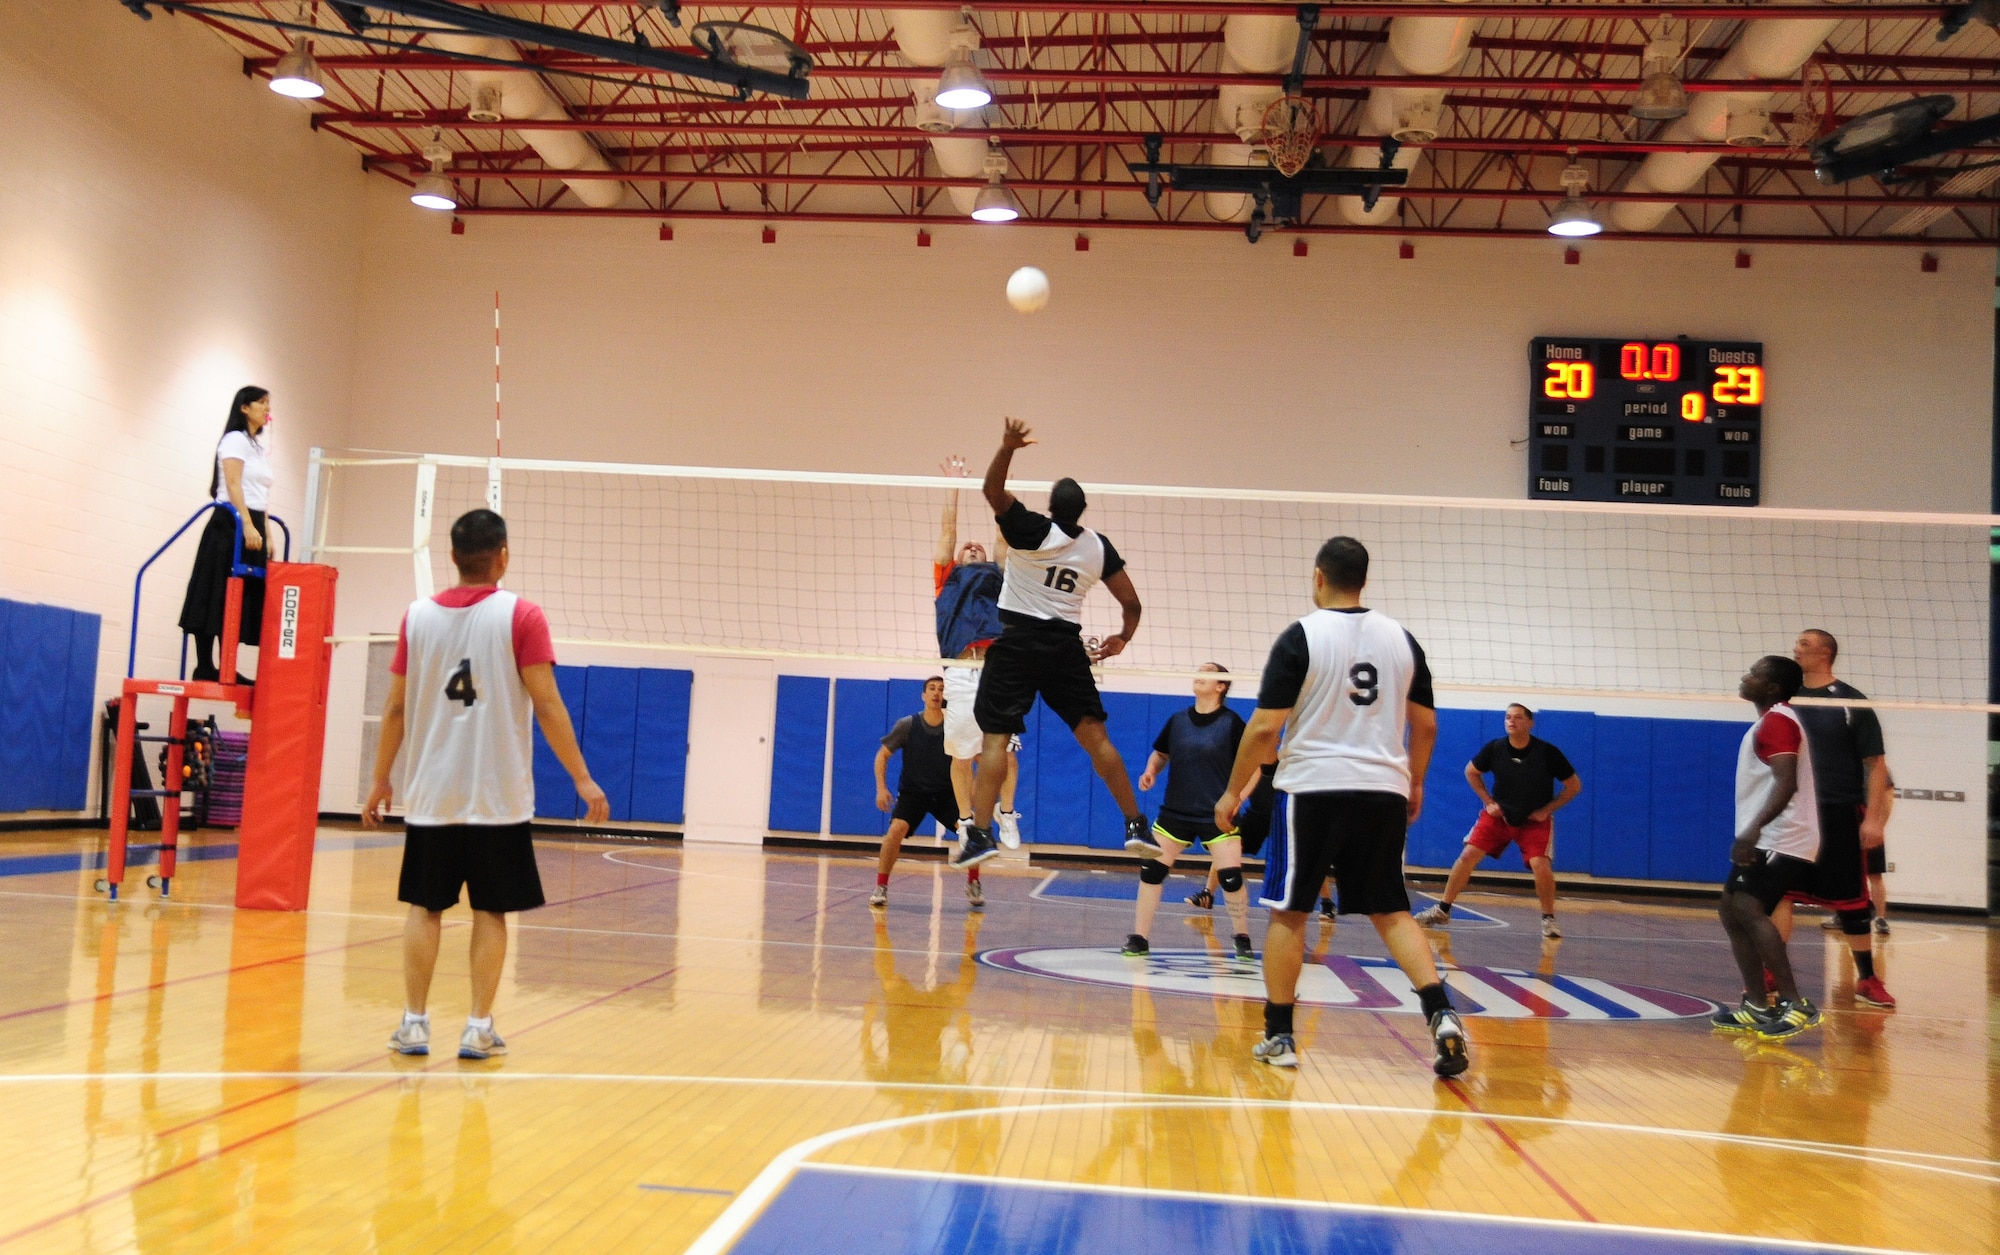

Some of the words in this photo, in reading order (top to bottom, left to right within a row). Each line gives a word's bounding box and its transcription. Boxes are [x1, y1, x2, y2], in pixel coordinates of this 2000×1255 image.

[1546, 344, 1582, 360] Home
[1709, 348, 1755, 364] Guests
[1545, 362, 1594, 399] 20
[1713, 367, 1764, 405] 23
[1624, 403, 1667, 416] period
[1544, 425, 1568, 435] won
[1629, 428, 1662, 440] game
[1724, 431, 1749, 441] won
[1539, 478, 1569, 491] fouls
[1622, 480, 1665, 495] player
[1720, 485, 1751, 498] fouls
[1044, 566, 1079, 593] 16
[445, 659, 477, 707] 4
[1349, 662, 1377, 705] 9
